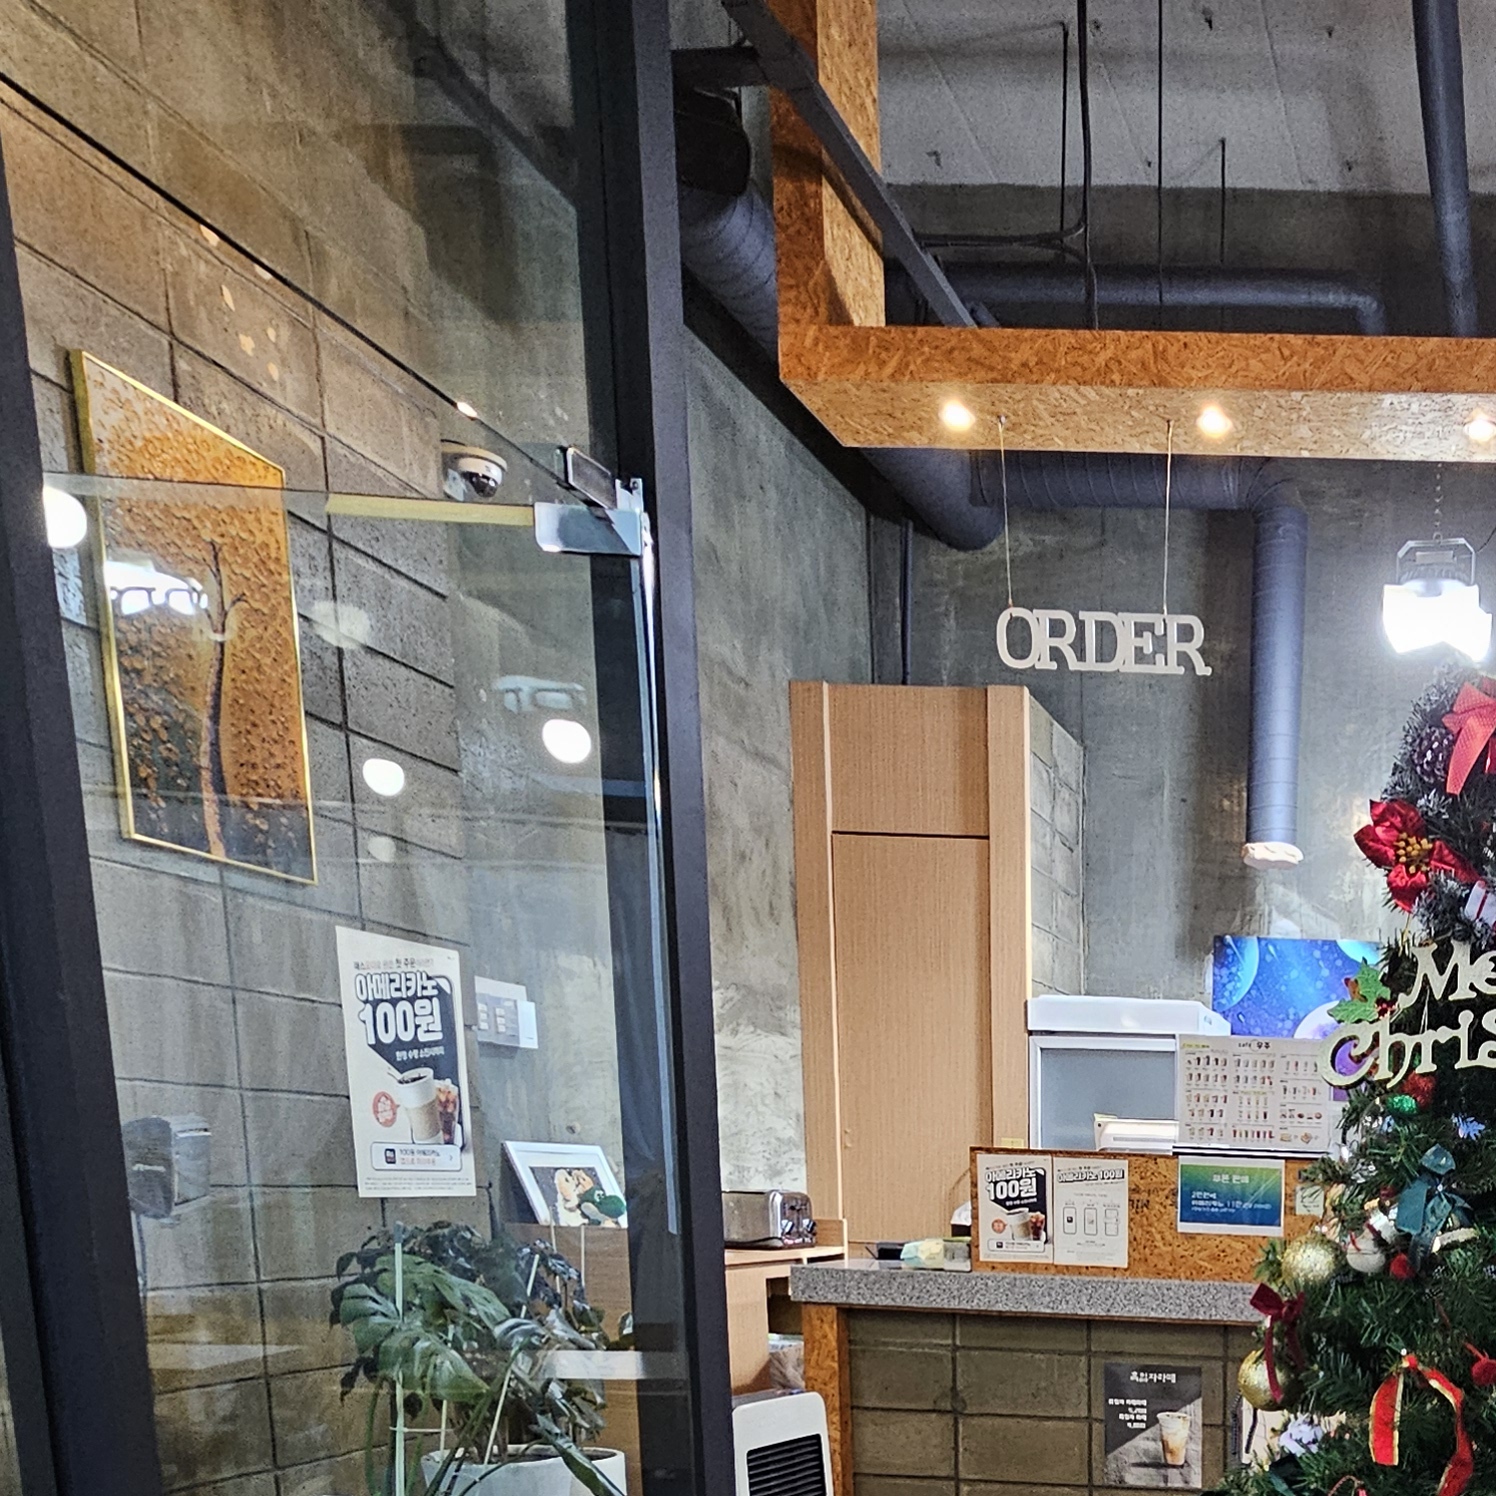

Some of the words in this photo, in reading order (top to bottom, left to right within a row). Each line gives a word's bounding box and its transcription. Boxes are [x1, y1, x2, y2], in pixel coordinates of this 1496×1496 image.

[996, 606, 1212, 676] ORDER
[355, 970, 439, 1001] 아메리카노
[359, 997, 443, 1045] 100원
[985, 1166, 1036, 1183] 아메리카노
[986, 1177, 1037, 1201] 100원
